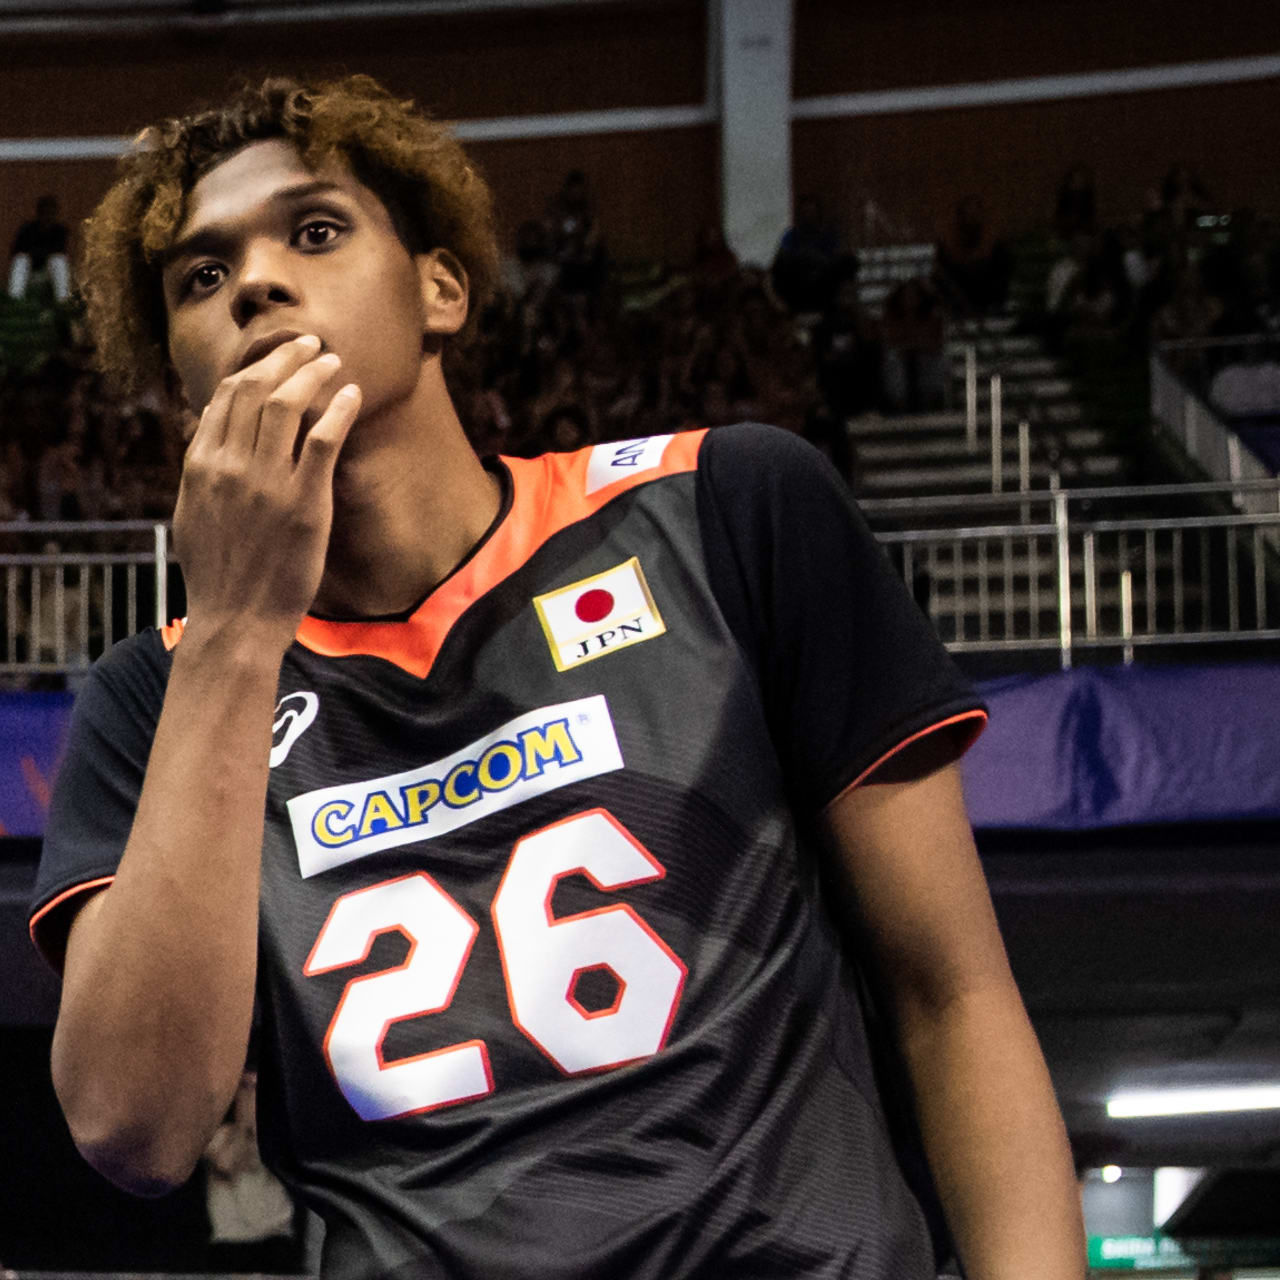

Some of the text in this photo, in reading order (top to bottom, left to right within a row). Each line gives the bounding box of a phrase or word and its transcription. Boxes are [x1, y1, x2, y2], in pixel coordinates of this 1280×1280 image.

[576, 616, 643, 658] JPN
[311, 717, 583, 848] CAPCOM
[303, 808, 688, 1122] 26
